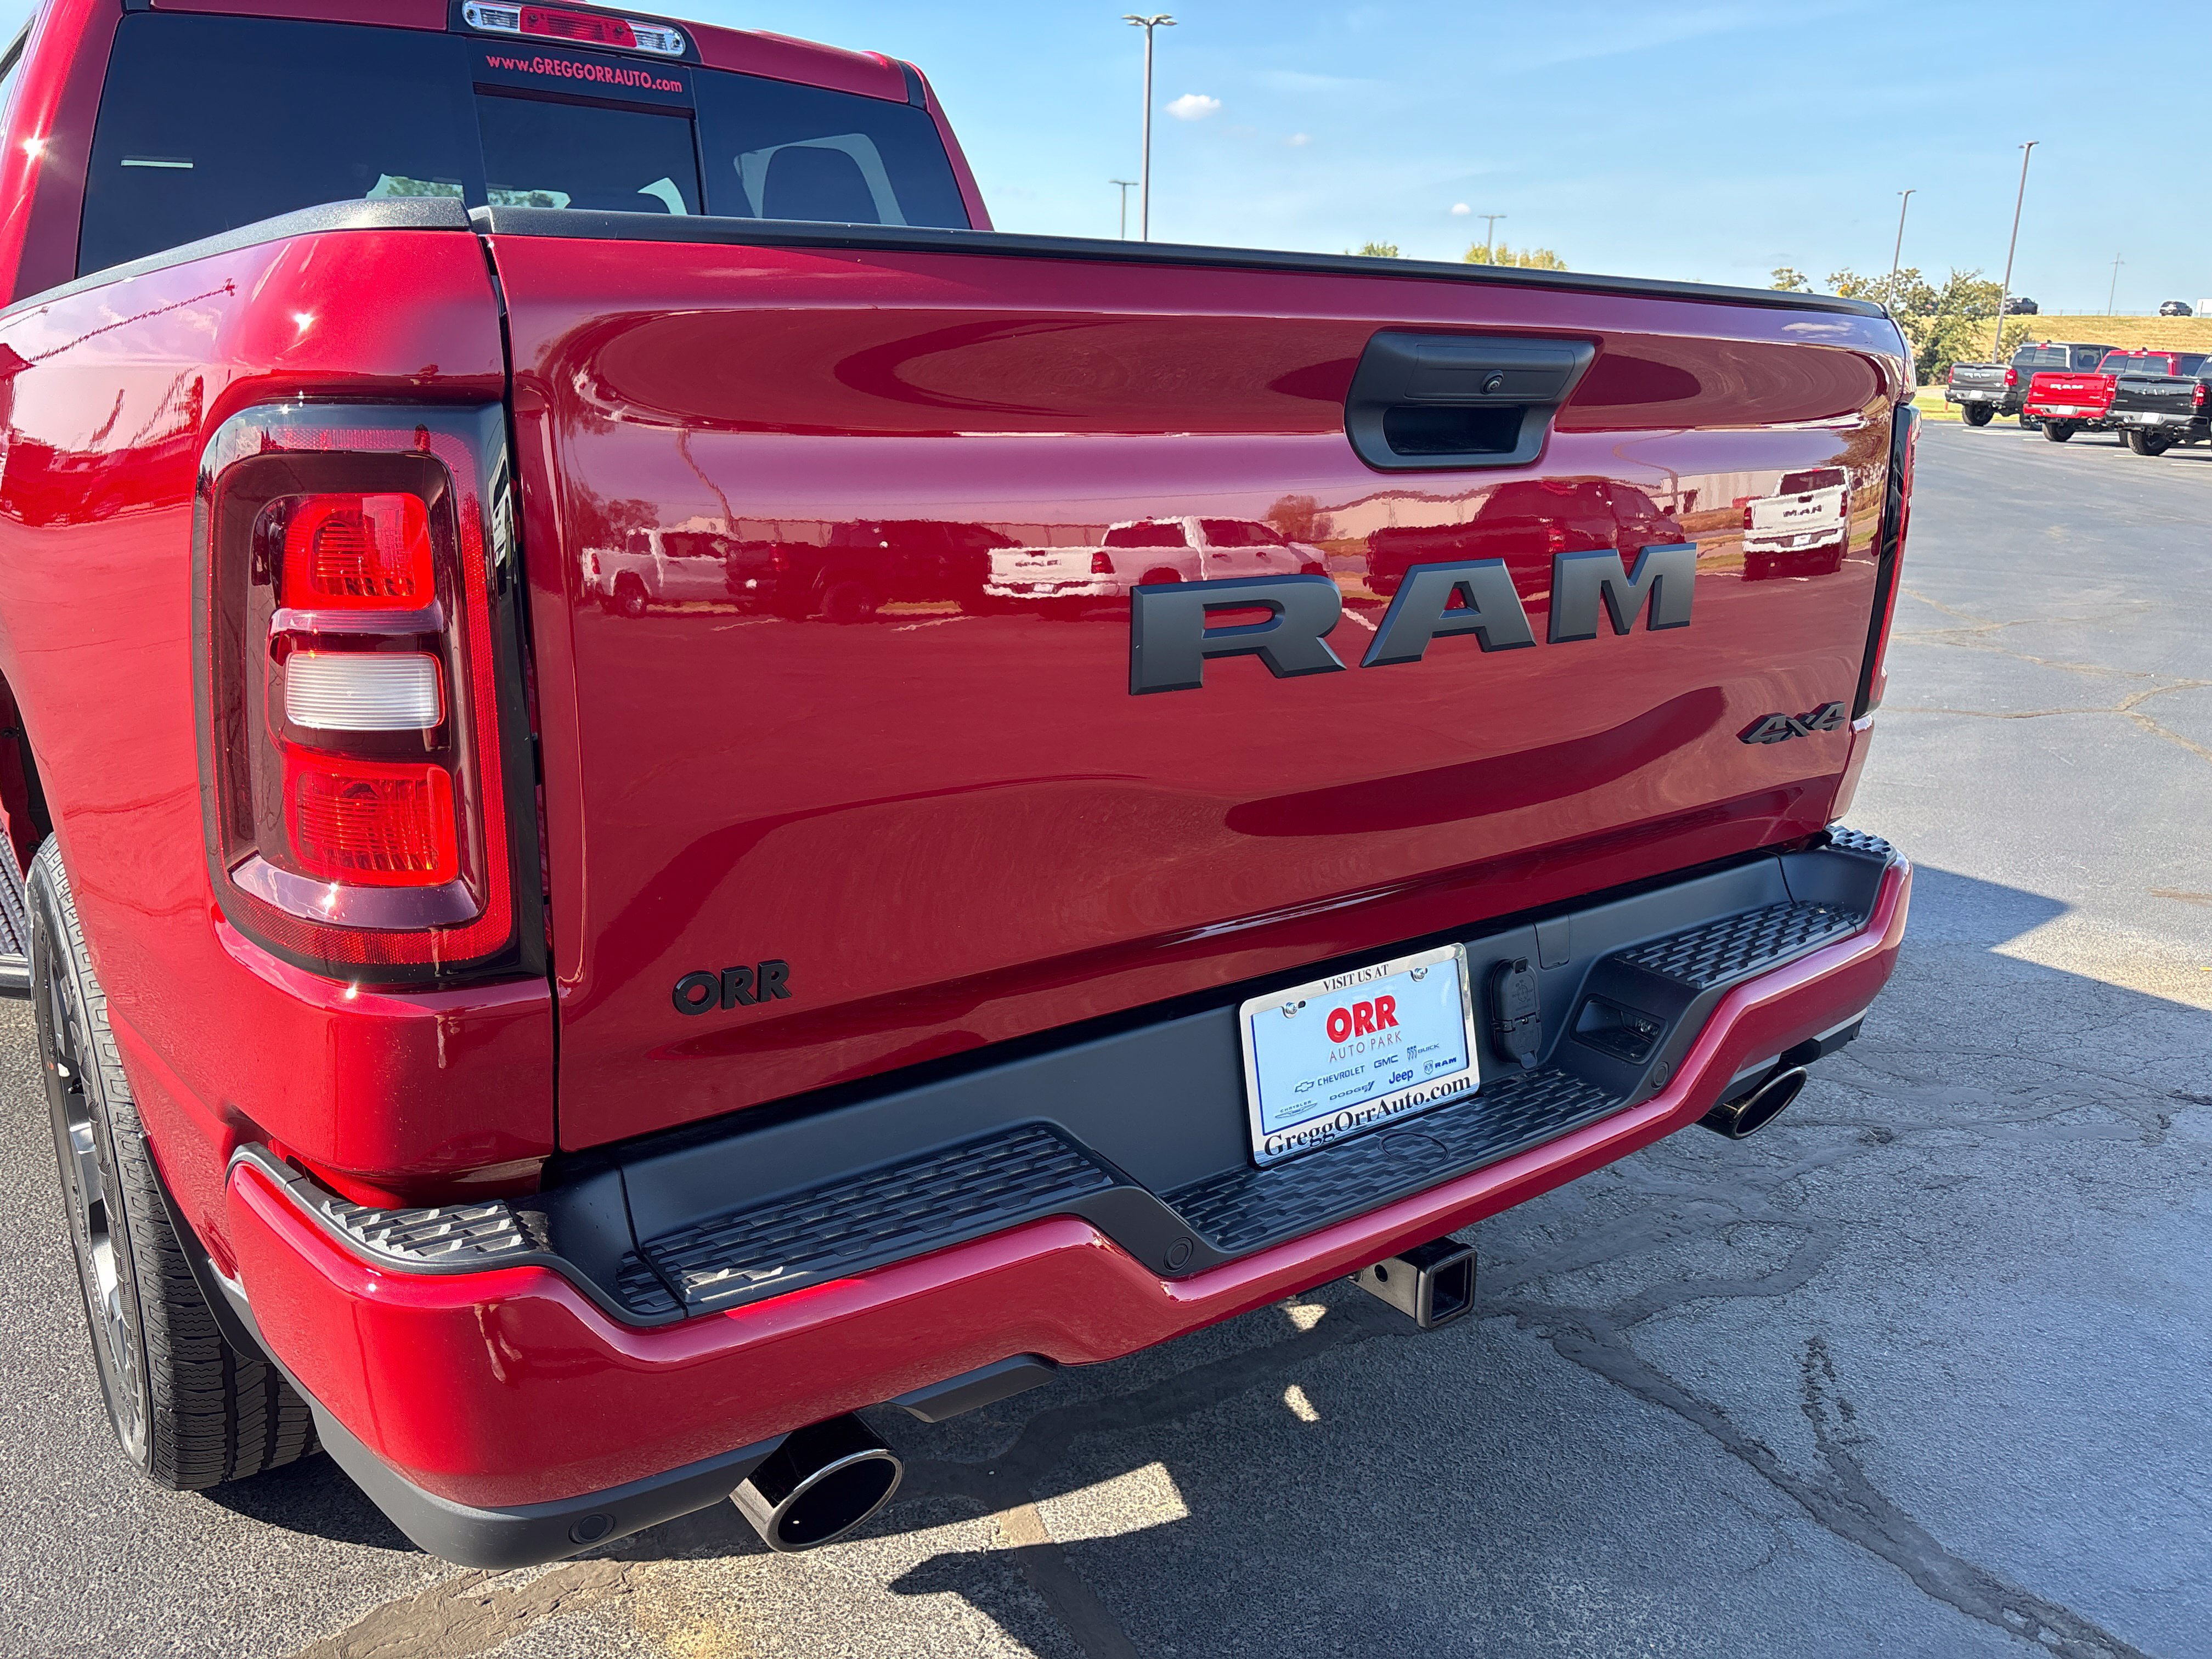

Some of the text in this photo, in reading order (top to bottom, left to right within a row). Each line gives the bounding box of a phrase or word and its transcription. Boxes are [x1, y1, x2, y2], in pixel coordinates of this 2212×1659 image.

[486, 55, 683, 93] www.GREGGORRAUTO.com
[1128, 542, 1698, 696] RAM
[672, 959, 792, 1015] ORR
[1323, 964, 1389, 991] VISIT US AT
[1326, 995, 1400, 1043] ORR
[1329, 1030, 1402, 1063] AUTO PARK
[1418, 1043, 1440, 1054] BUICK
[1374, 1054, 1399, 1069] GMC
[1435, 1057, 1457, 1068] RAM
[1317, 1065, 1365, 1086] CHEVROLET
[1389, 1069, 1414, 1084] Jeep
[1329, 1085, 1368, 1101] DODGE
[1264, 1076, 1471, 1156] GreggOrrAuto.com
[1280, 1100, 1312, 1113] CHRYSLER
